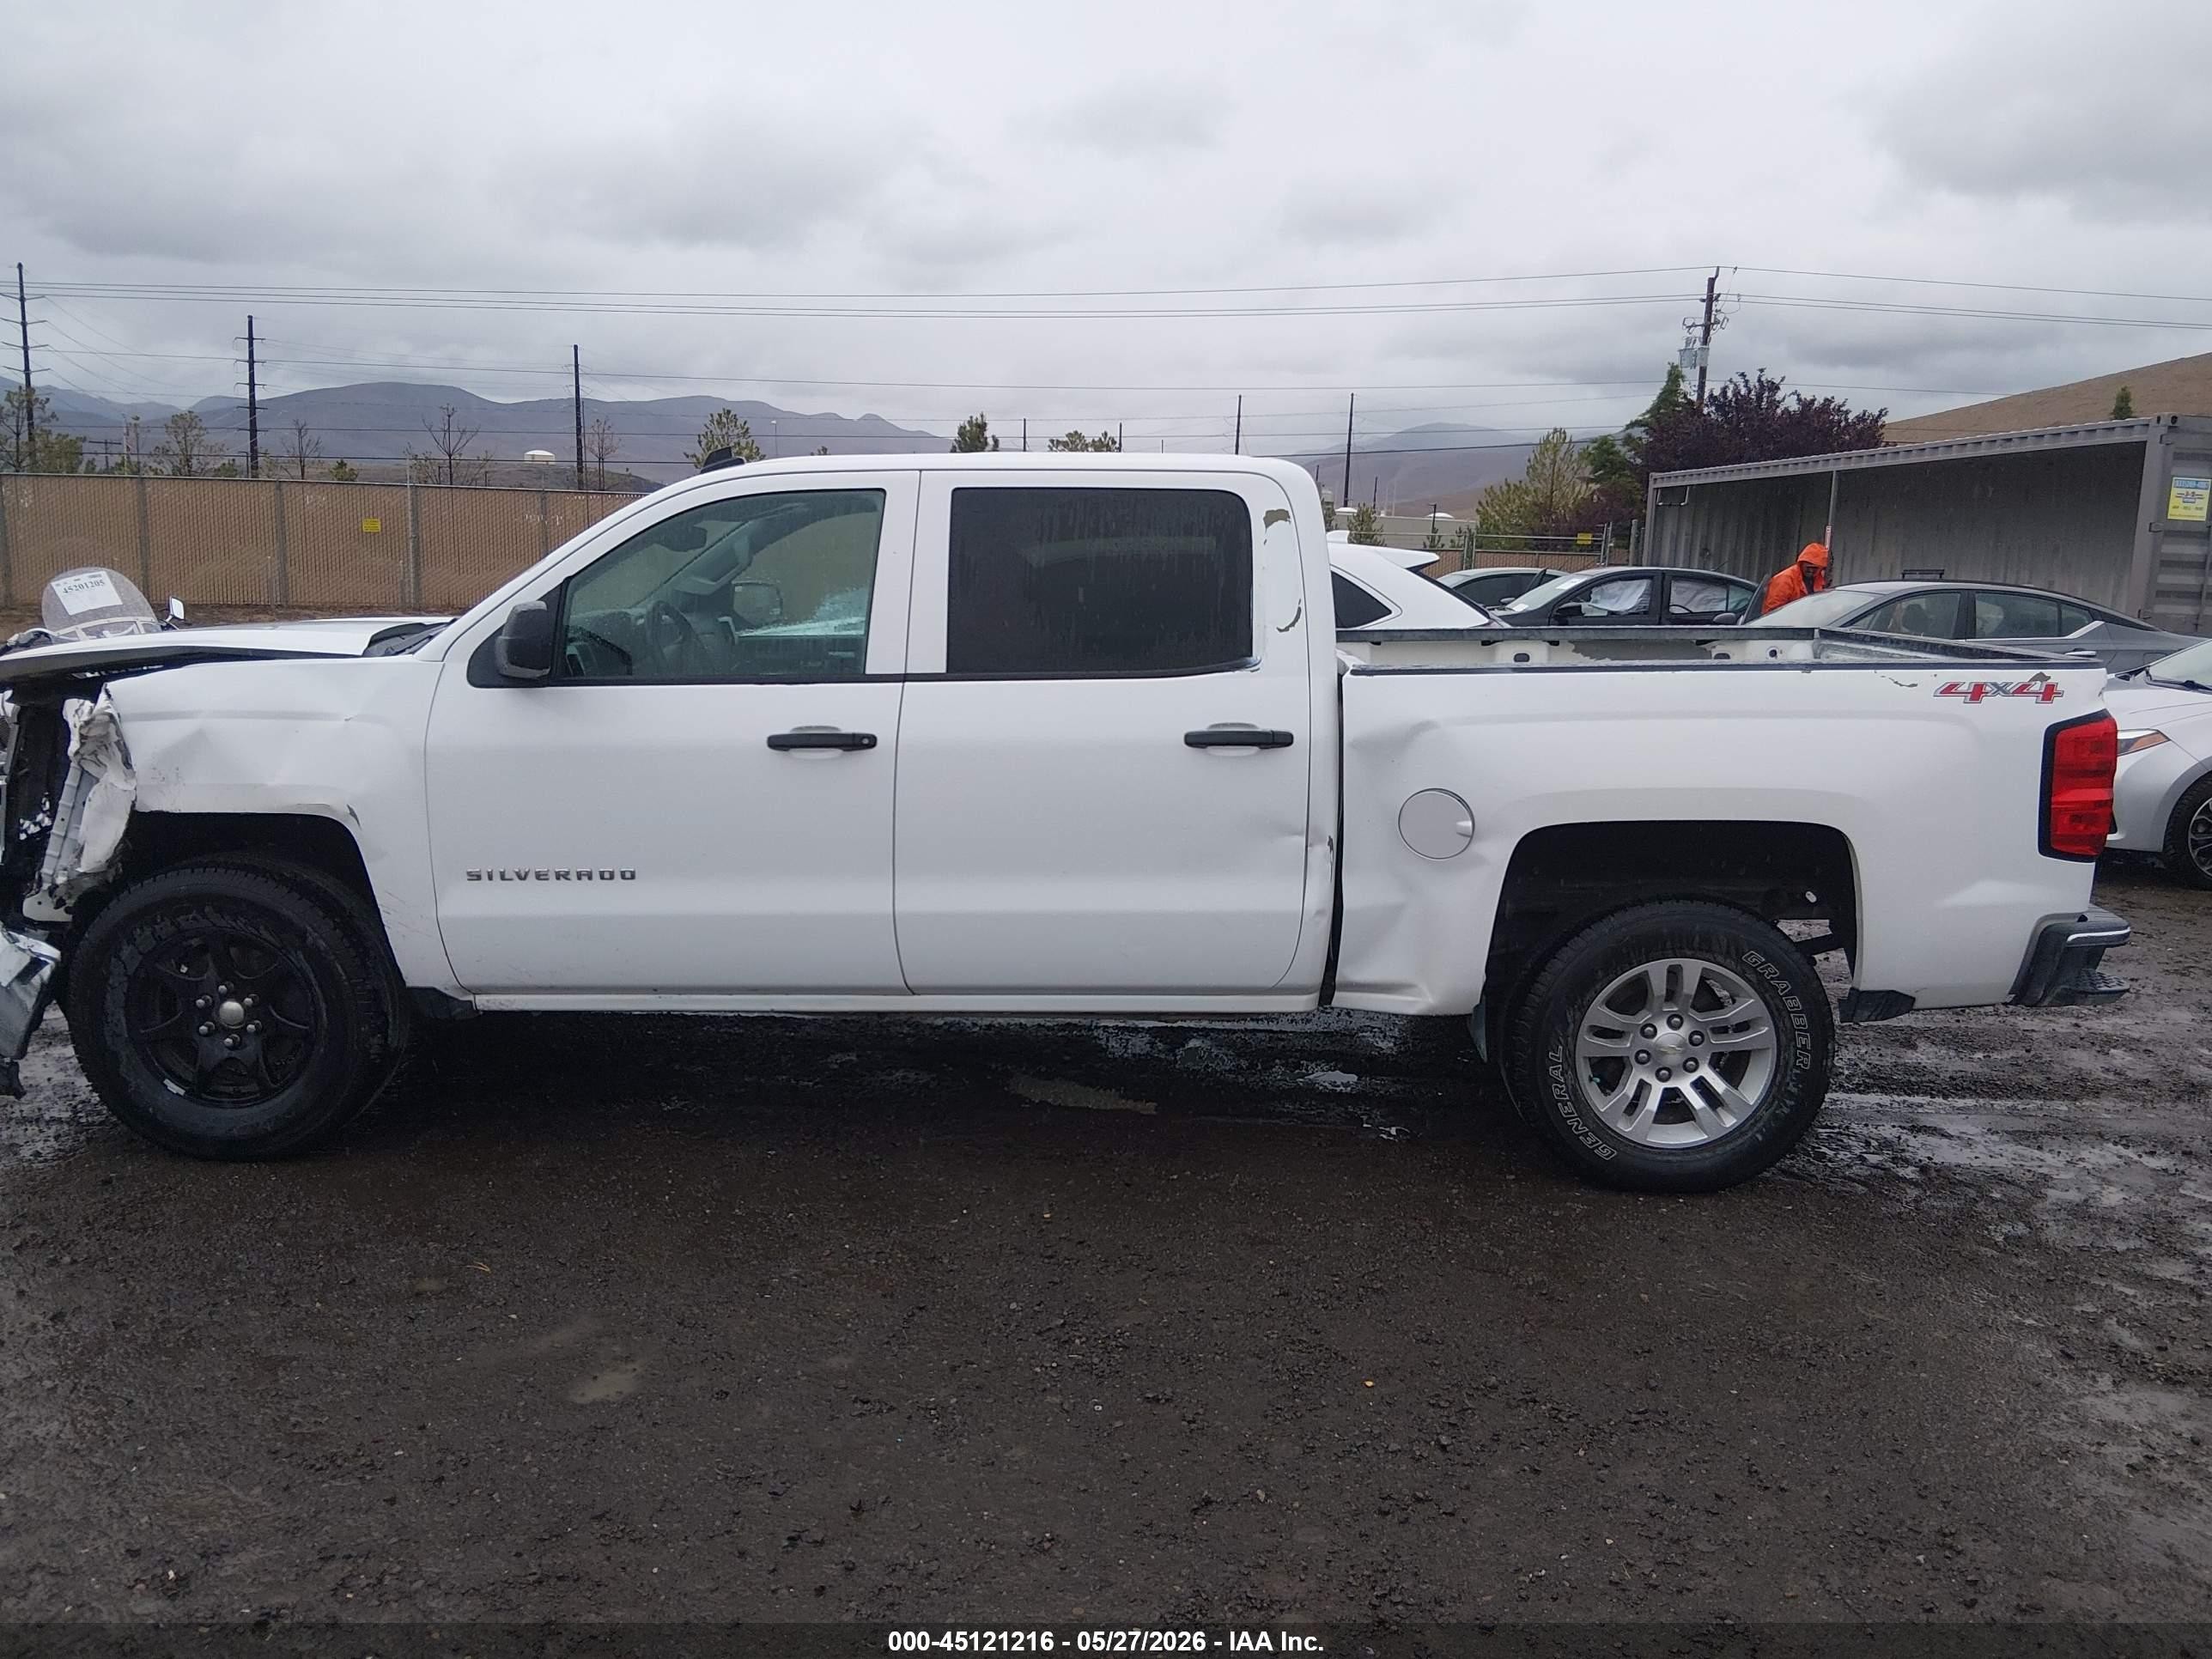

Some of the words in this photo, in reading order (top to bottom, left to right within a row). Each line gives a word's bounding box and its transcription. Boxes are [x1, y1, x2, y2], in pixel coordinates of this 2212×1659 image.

[466, 868, 635, 881] SILVERADO
[1742, 951, 1810, 1069] GRABBER
[1549, 1044, 1617, 1160] GENERAL
